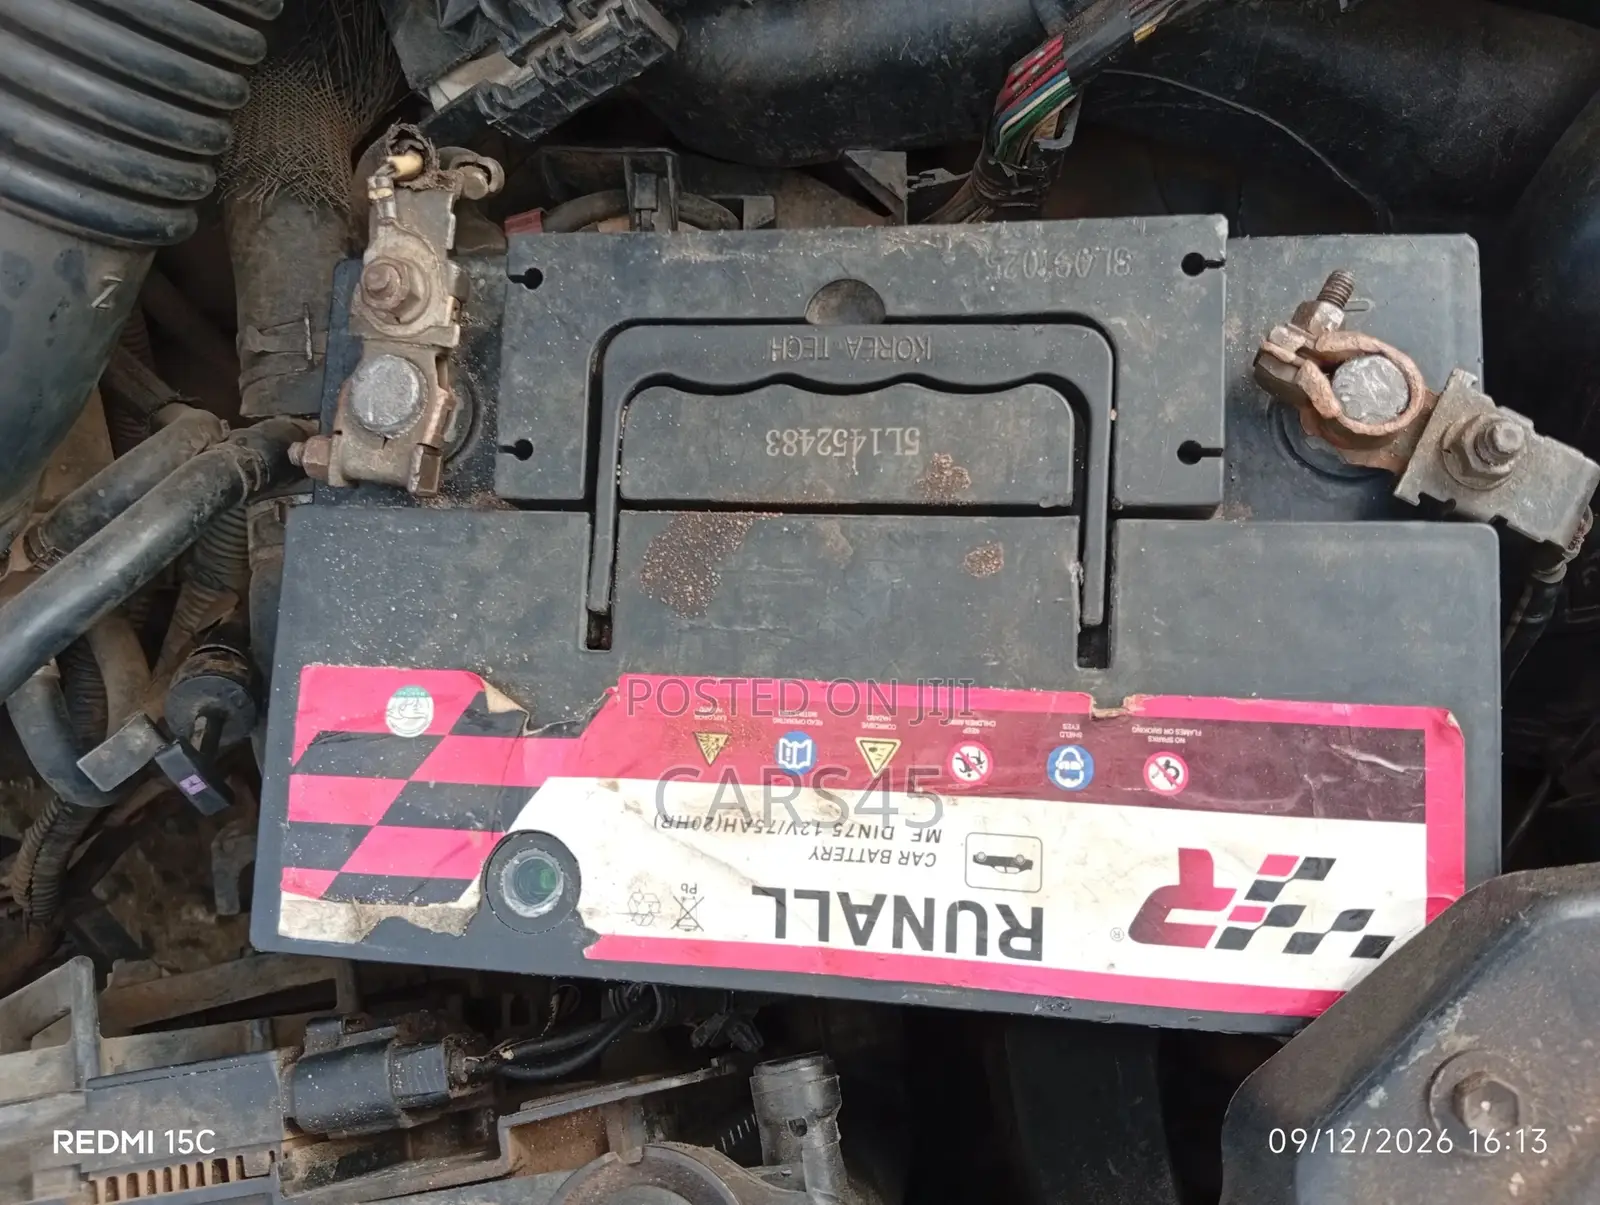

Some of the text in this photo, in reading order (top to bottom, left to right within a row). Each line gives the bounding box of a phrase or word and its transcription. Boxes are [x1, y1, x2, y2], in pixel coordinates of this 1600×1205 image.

[770, 335, 931, 362] KOREA TECH
[766, 427, 920, 456] 5L1452483
[1147, 735, 1174, 743] SPARKS
[1163, 727, 1174, 735] OR
[1175, 728, 1202, 736] FLAMES
[653, 813, 823, 837] 12V/75AH(20HR)
[833, 821, 895, 841] DIN75
[808, 844, 937, 868] CAR BATTERY
[680, 882, 698, 895] Pb
[751, 885, 1044, 962] RUNALL
